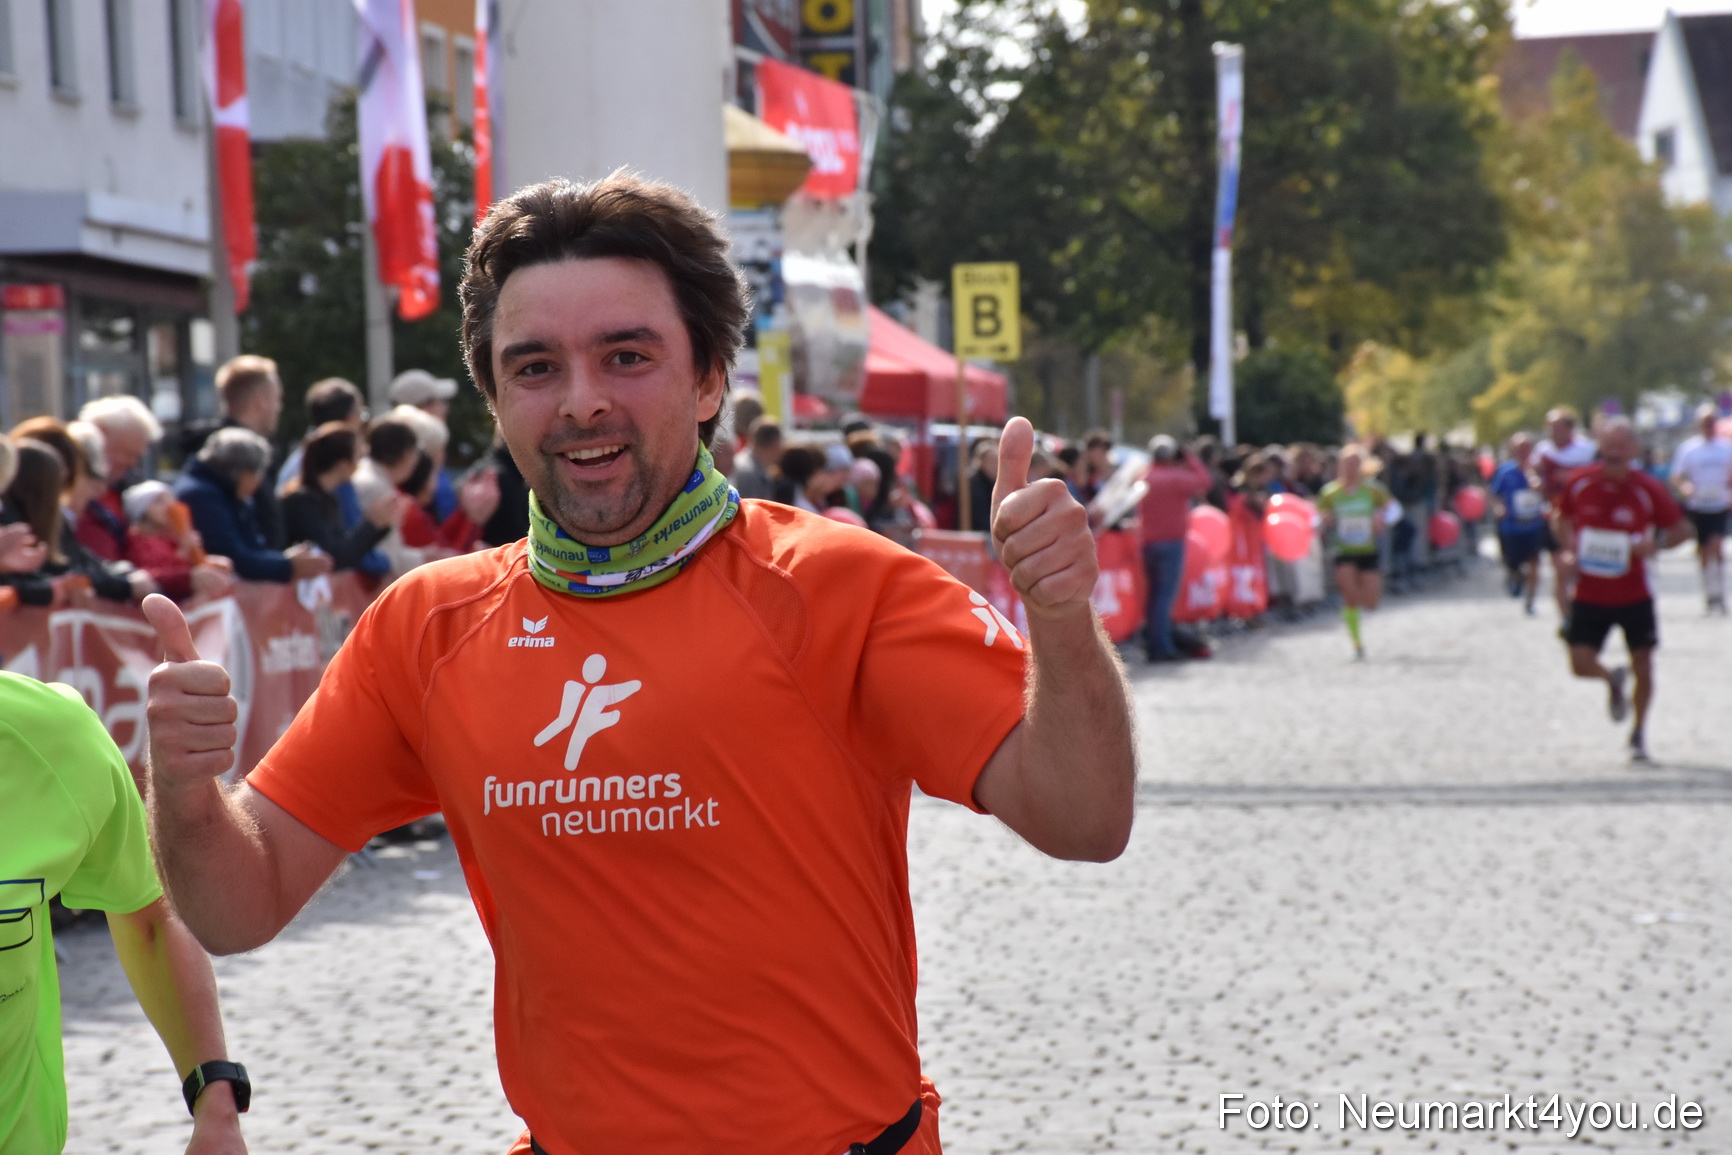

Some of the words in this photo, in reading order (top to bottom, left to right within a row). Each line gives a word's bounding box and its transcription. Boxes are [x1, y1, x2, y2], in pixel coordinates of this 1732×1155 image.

[971, 293, 1002, 338] B
[652, 495, 713, 545] neumarkt
[507, 635, 555, 648] erima
[483, 772, 682, 816] funrunners
[541, 796, 721, 837] neumarkt
